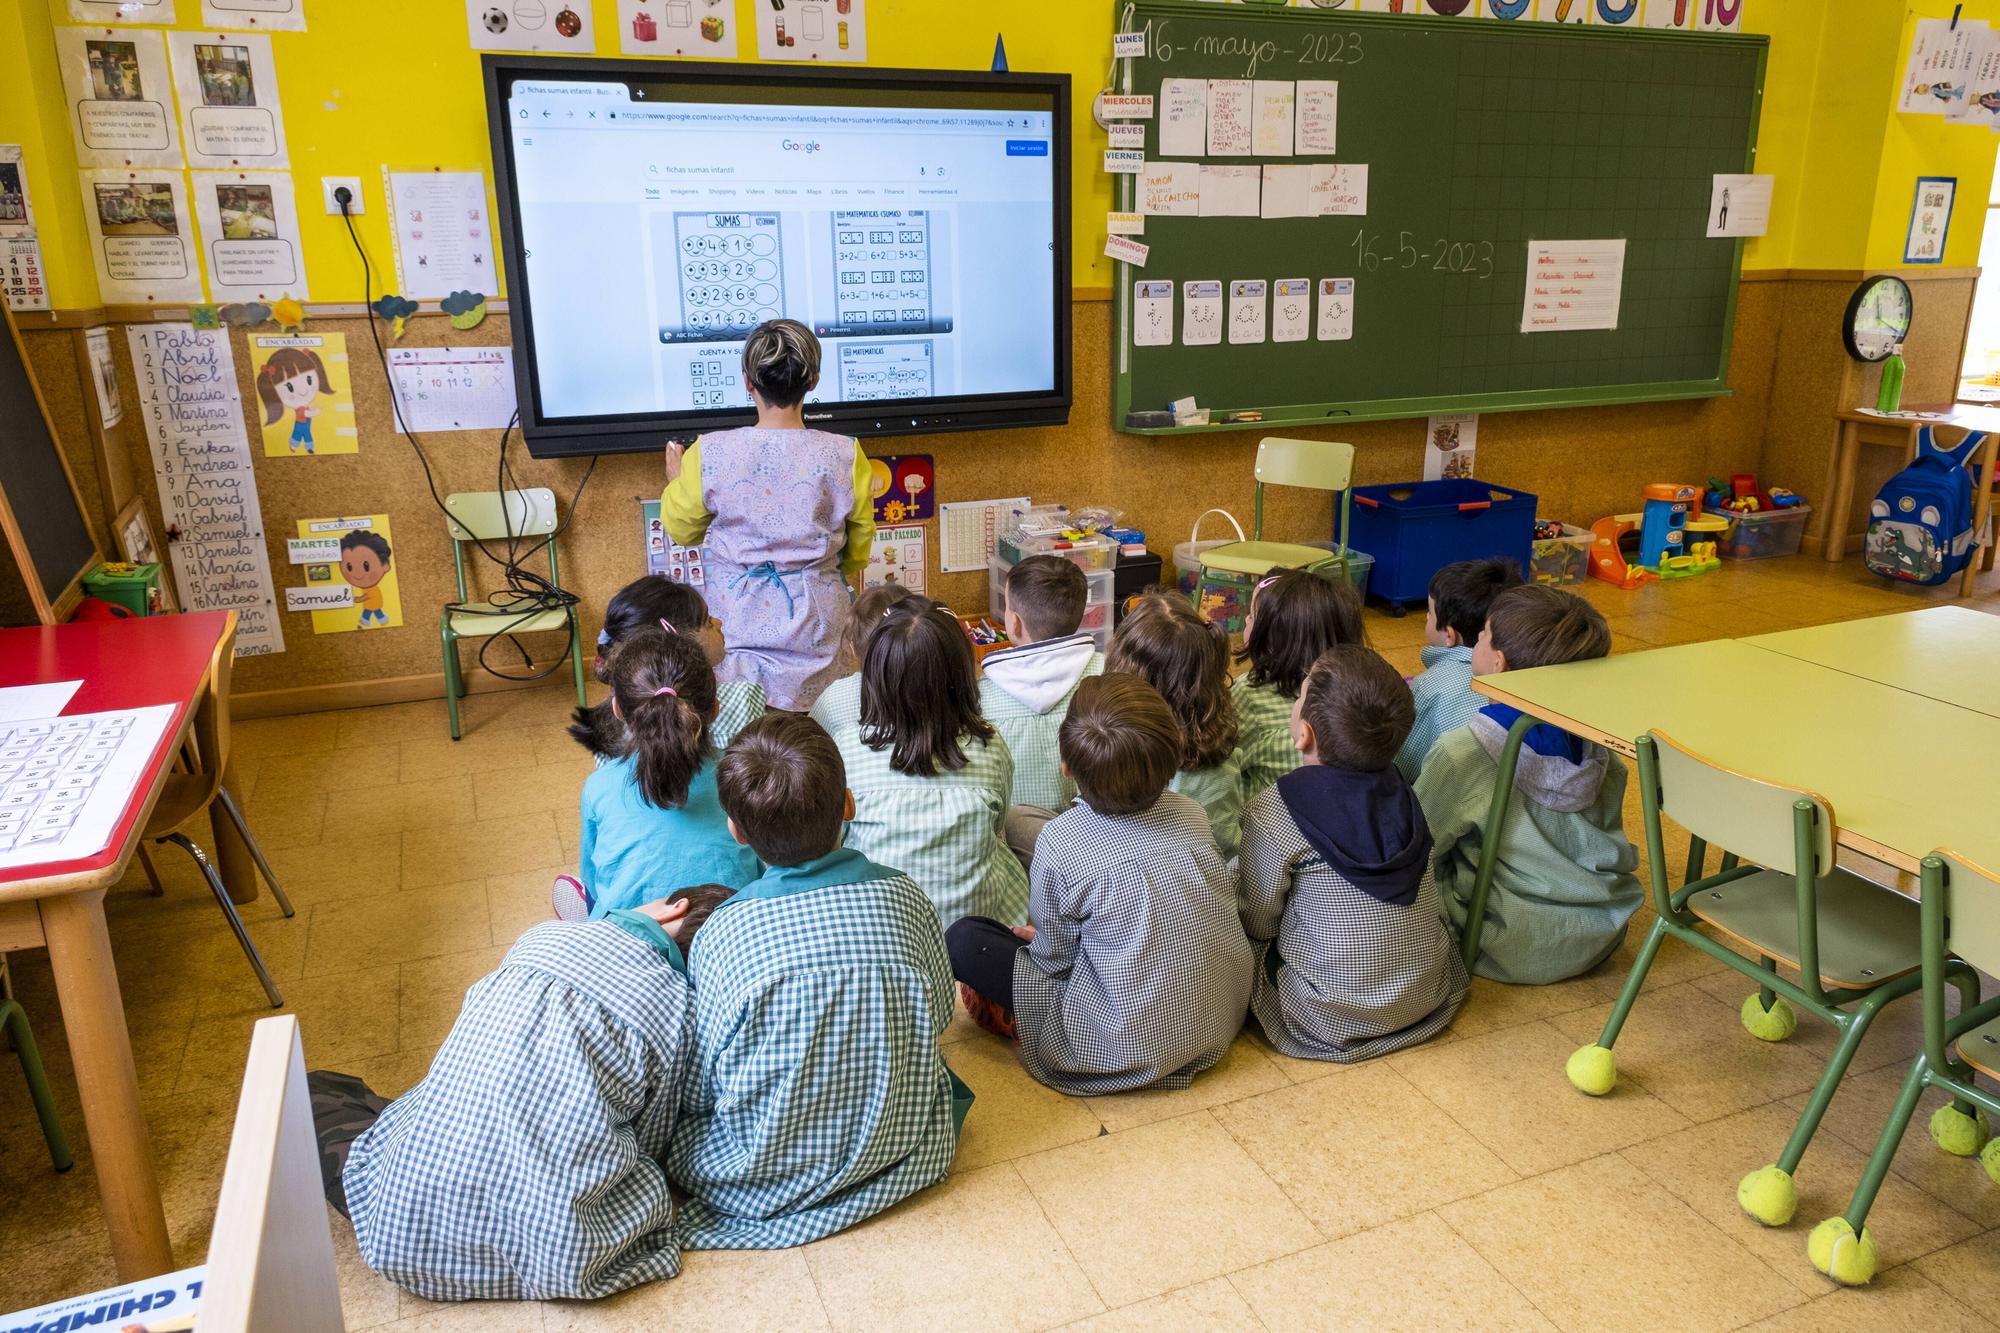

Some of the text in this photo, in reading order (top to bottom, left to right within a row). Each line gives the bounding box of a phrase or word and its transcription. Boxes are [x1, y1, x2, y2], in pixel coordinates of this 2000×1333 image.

[1115, 35, 1143, 43] LUNES
[1117, 44, 1142, 54] lunes
[527, 87, 546, 95] fichas
[1103, 97, 1152, 105] MIERCOLES
[782, 139, 821, 154] Google
[1105, 152, 1143, 160] VIERNES
[666, 166, 686, 174] fichas
[711, 166, 735, 174] infantil
[708, 188, 736, 197] Shopping
[807, 189, 822, 197] Maps
[715, 216, 740, 227] SUMAS
[708, 240, 740, 251] 4 1
[1108, 236, 1147, 254] DOMINGO
[10, 257, 34, 265] 4 5
[12, 267, 38, 276] 11 12
[711, 263, 743, 276] 3 2
[11, 277, 39, 286] 18 19
[11, 287, 43, 296] 25 26
[712, 288, 745, 300] 2 6
[715, 313, 746, 325] 1 2
[140, 330, 214, 348] 1 Pablo
[265, 339, 315, 347] ENCARGADA
[145, 349, 218, 367] 2 Abril
[147, 365, 221, 384] 3 Noel
[416, 366, 469, 376] 2 4 5
[400, 380, 408, 389] 8
[432, 379, 442, 388] 10
[447, 378, 458, 388] 11
[462, 378, 473, 388] 12
[152, 385, 225, 402] 4 Claudia
[154, 404, 228, 420] 5 Martina
[159, 420, 231, 439] 6 Jayden
[161, 439, 235, 456] 7 Érika
[166, 457, 238, 473] 8 Andrea
[168, 474, 240, 490] 9 Ana
[173, 488, 244, 508] 10 David
[175, 506, 247, 525] 11 Gabriel
[892, 509, 899, 518] 2
[318, 521, 364, 530] ENCARGADO
[179, 523, 250, 542] 12 Samuel
[880, 530, 921, 541] HAN FALTADO
[182, 540, 252, 559] 13 Daniela
[290, 540, 339, 549] MARTES
[910, 549, 916, 558] 2
[186, 560, 255, 577] 14 María
[190, 575, 259, 594] 15 Carolina
[194, 594, 260, 608] 16 Mateo
[288, 588, 351, 605] Samuel
[237, 608, 265, 622] tín
[236, 623, 268, 636] ndra
[186, 1280, 204, 1299] L
